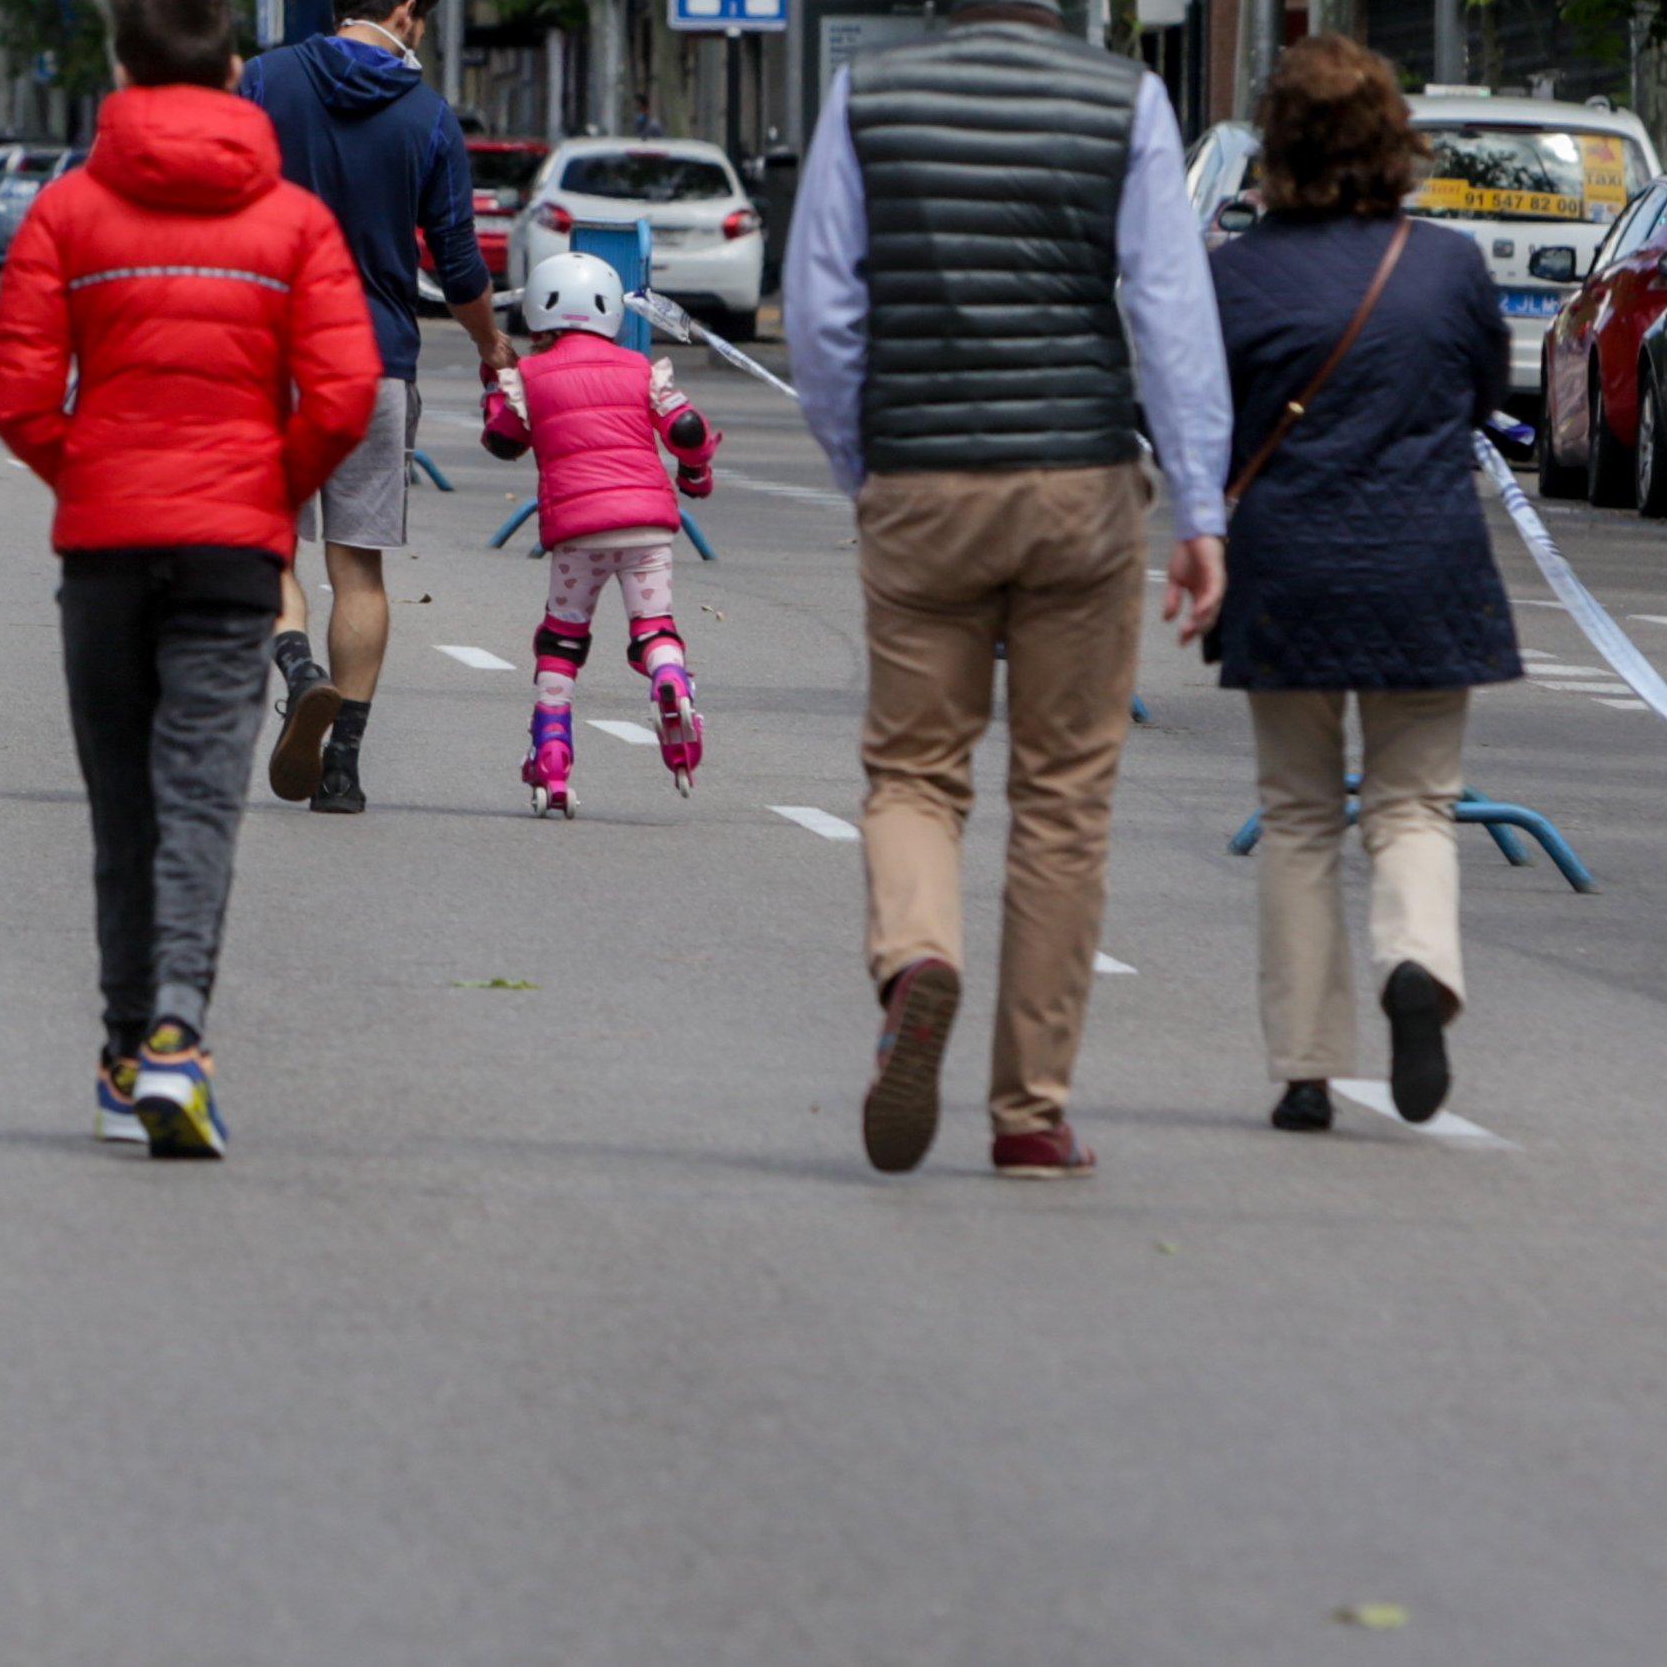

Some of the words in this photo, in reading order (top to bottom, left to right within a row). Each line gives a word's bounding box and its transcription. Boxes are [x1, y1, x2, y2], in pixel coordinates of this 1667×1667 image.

[1464, 191, 1485, 208] 91
[1492, 193, 1524, 210] 547
[1530, 196, 1551, 212] 82
[1556, 198, 1577, 214] 00
